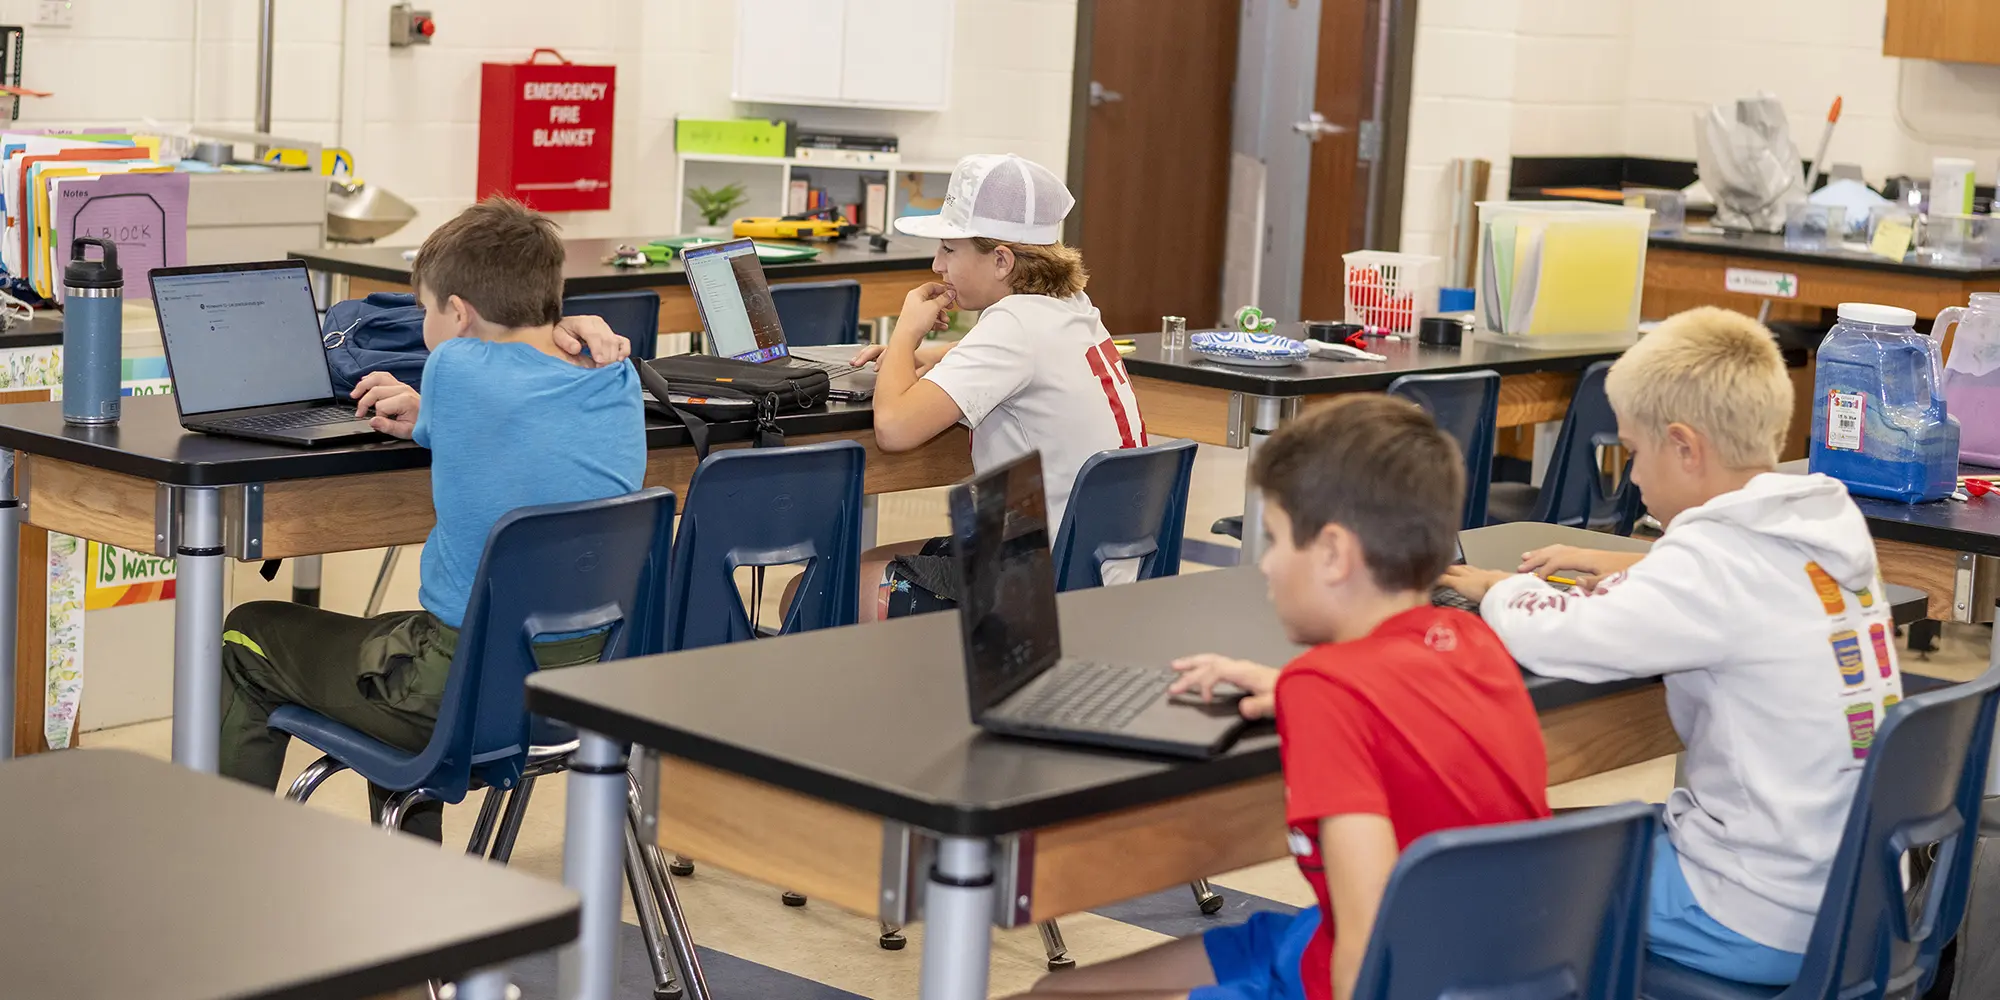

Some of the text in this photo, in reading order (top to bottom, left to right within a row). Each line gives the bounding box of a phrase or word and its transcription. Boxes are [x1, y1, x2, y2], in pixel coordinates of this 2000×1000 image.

[524, 82, 607, 100] EMERGENCY
[549, 105, 580, 123] FIRE
[533, 128, 595, 146] BLANKET
[1834, 397, 1859, 409] Sand
[100, 543, 116, 582] IS
